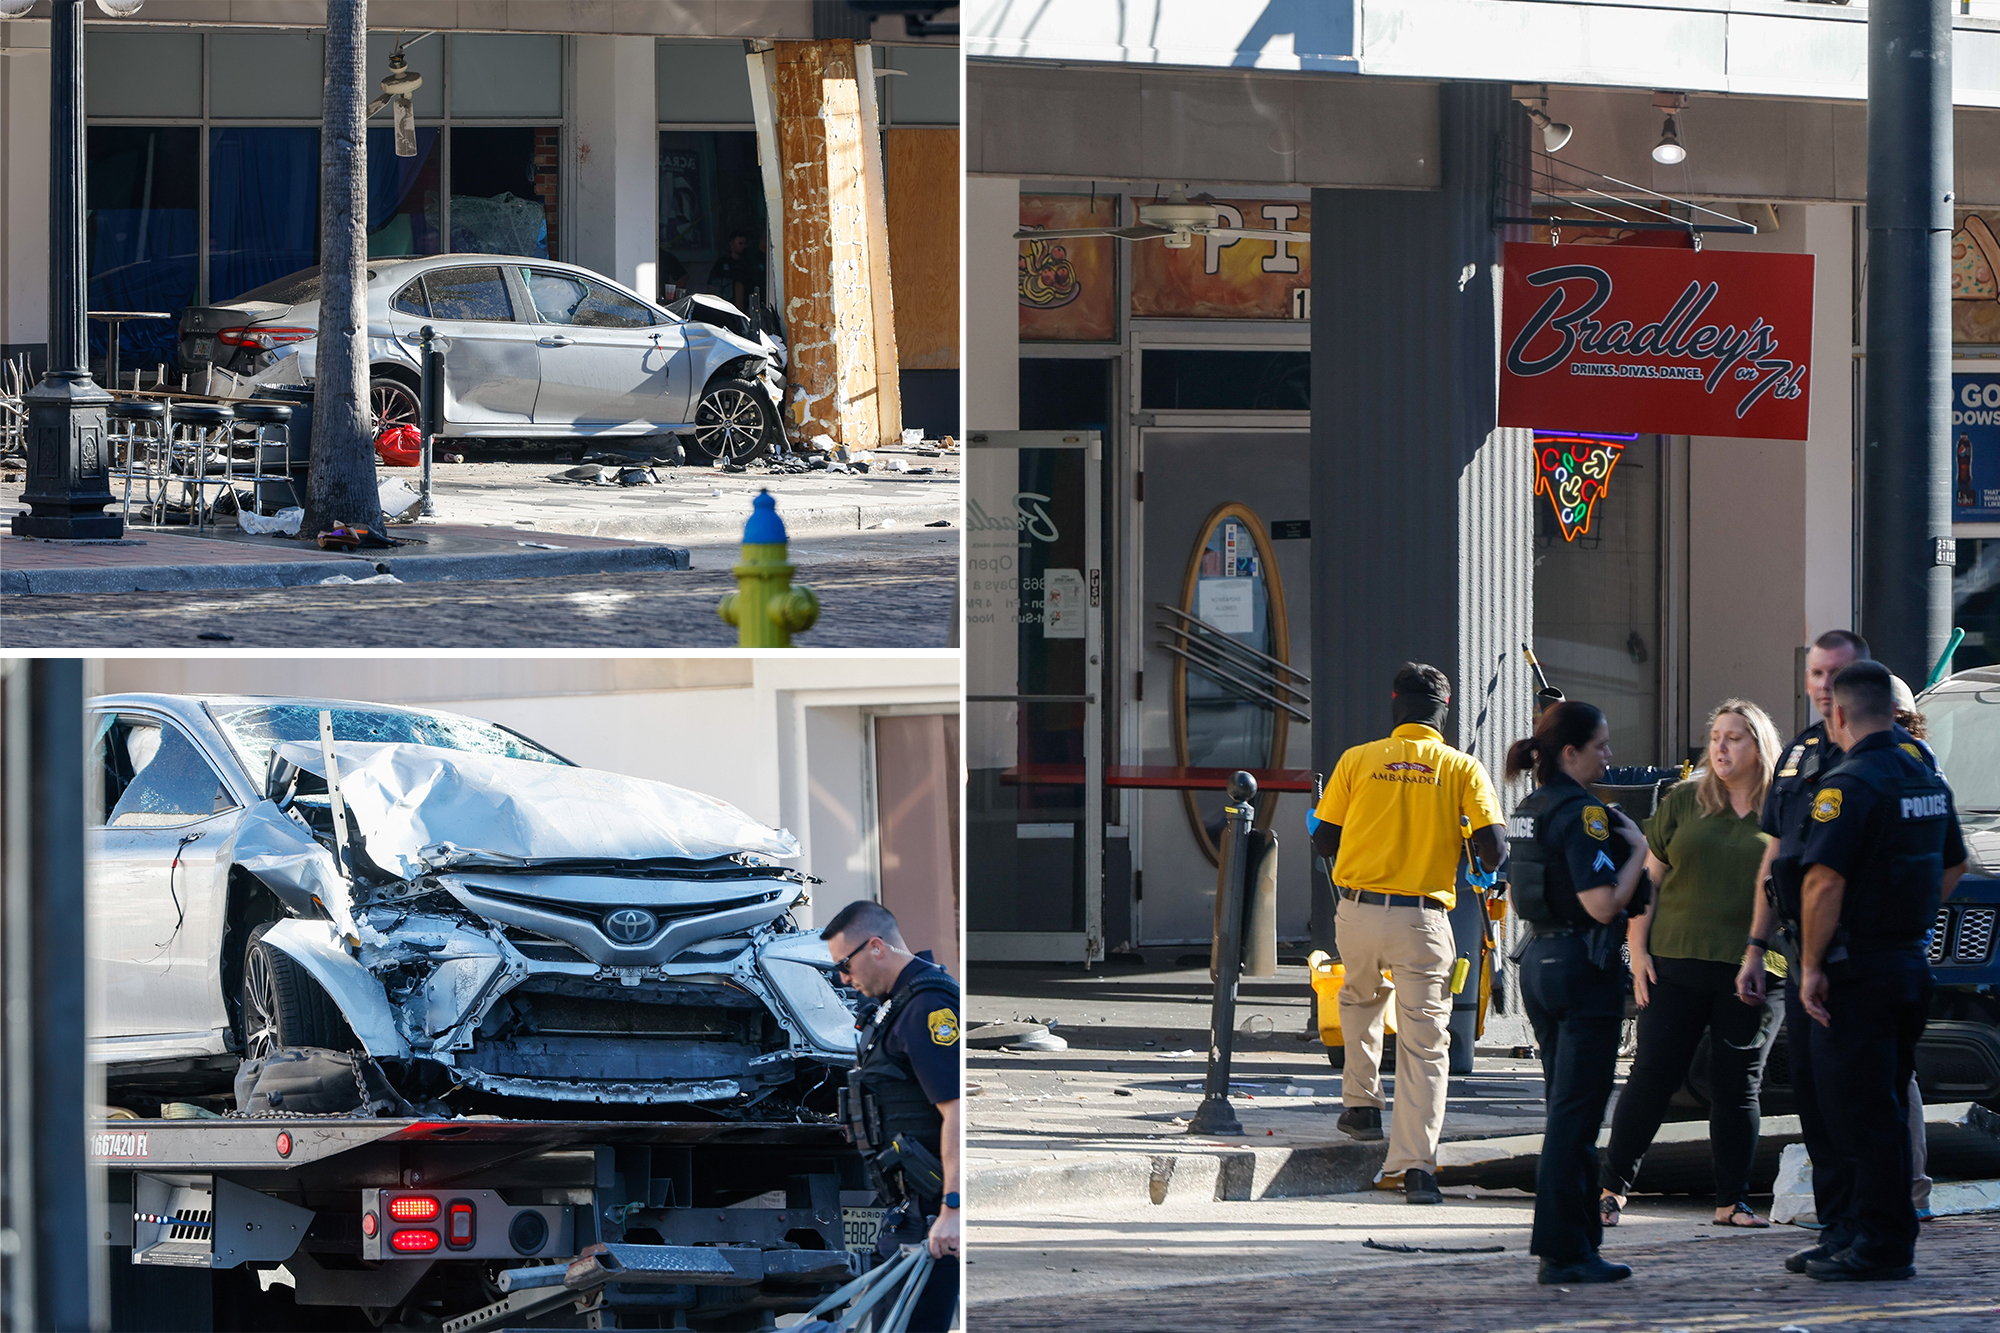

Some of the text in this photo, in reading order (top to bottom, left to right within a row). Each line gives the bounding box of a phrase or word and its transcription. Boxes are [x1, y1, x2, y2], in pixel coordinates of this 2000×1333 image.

[1506, 264, 1778, 394] Bradley's
[1570, 362, 1704, 380] DRINKS. DIVAS. DANCE.
[1734, 359, 1806, 419] on 7th
[1091, 570, 1099, 605] PUSH
[1900, 793, 1948, 819] POLICE
[90, 1133, 149, 1157] 1667420 FL
[851, 1210, 886, 1219] FLORIDA
